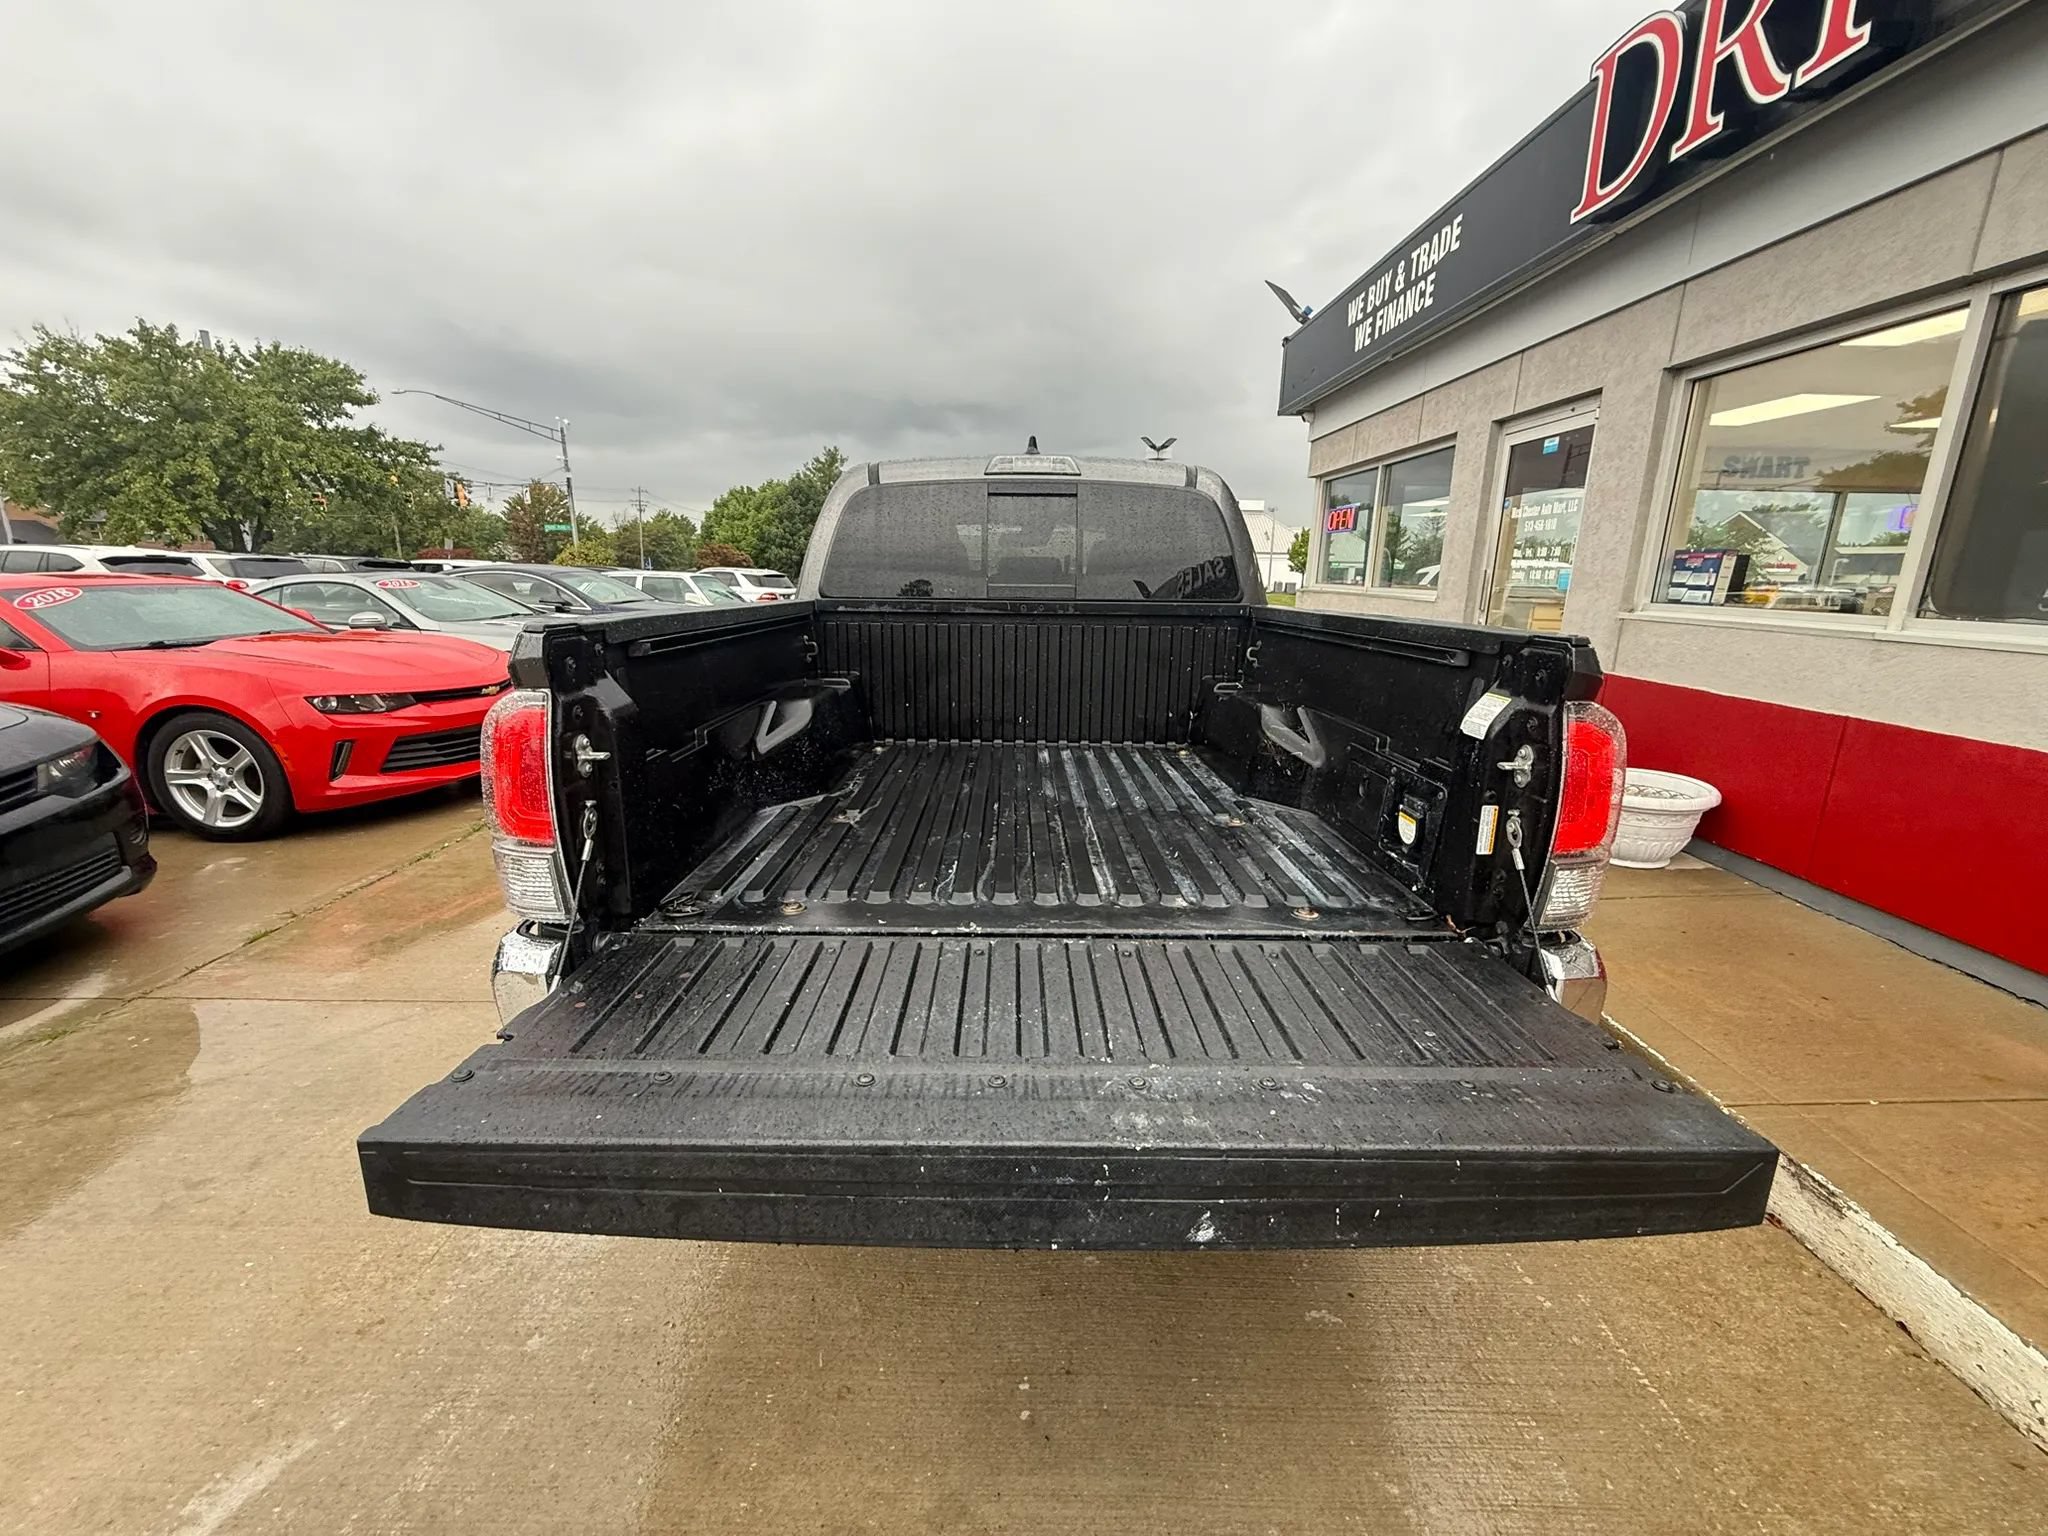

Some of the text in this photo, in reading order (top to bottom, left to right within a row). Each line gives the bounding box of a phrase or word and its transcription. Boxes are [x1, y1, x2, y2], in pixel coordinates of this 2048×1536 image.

[1347, 213, 1464, 327] WE BUY & TRADE
[1354, 271, 1437, 352] WE FINANCE
[1327, 508, 1356, 531] OPEN
[25, 587, 75, 607] 2018
